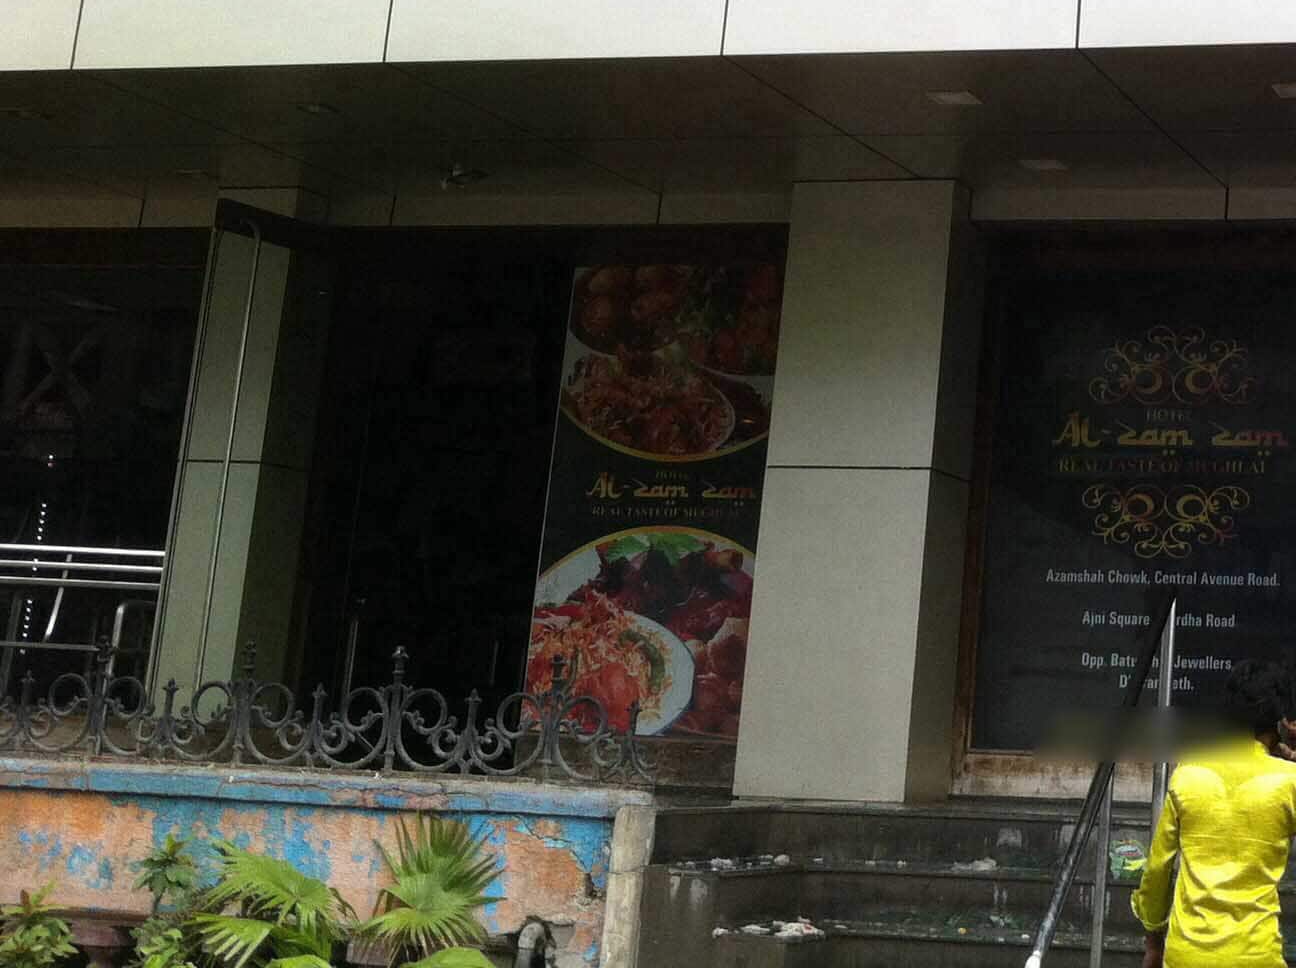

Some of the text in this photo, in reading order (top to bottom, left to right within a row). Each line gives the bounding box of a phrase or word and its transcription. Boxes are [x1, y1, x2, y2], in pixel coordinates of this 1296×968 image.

[1046, 568, 1105, 583] Azamshah
[1154, 571, 1198, 585] Central
[1200, 572, 1245, 586] Avenue
[1082, 610, 1106, 628] Ajni
